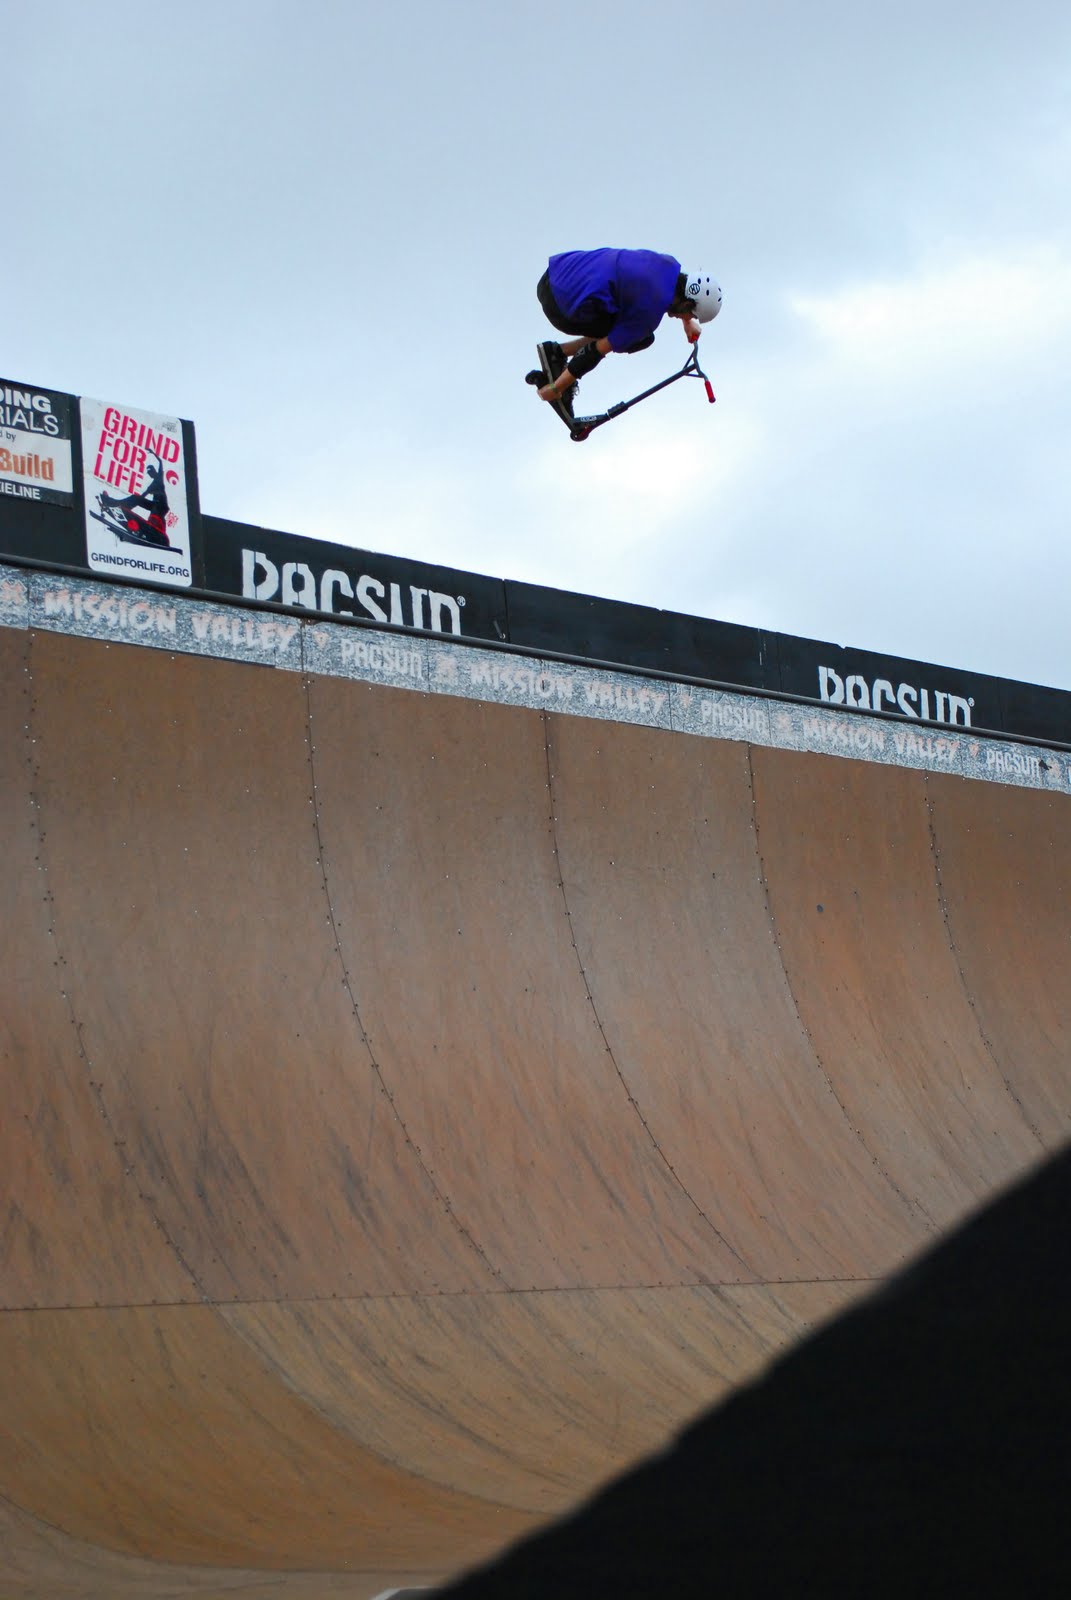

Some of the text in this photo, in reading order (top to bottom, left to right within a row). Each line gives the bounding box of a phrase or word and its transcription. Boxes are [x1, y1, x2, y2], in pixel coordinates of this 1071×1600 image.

[98, 430, 147, 473] FOR
[104, 407, 180, 464] GRIND
[0, 481, 41, 500] IELINE
[94, 454, 145, 496] LIFE
[91, 552, 190, 578] GRINDFORLIFE.ORG
[44, 589, 177, 633] MISSION
[192, 610, 298, 651] VALLEY
[803, 718, 885, 751] MISSION
[894, 733, 960, 762] VALLEY
